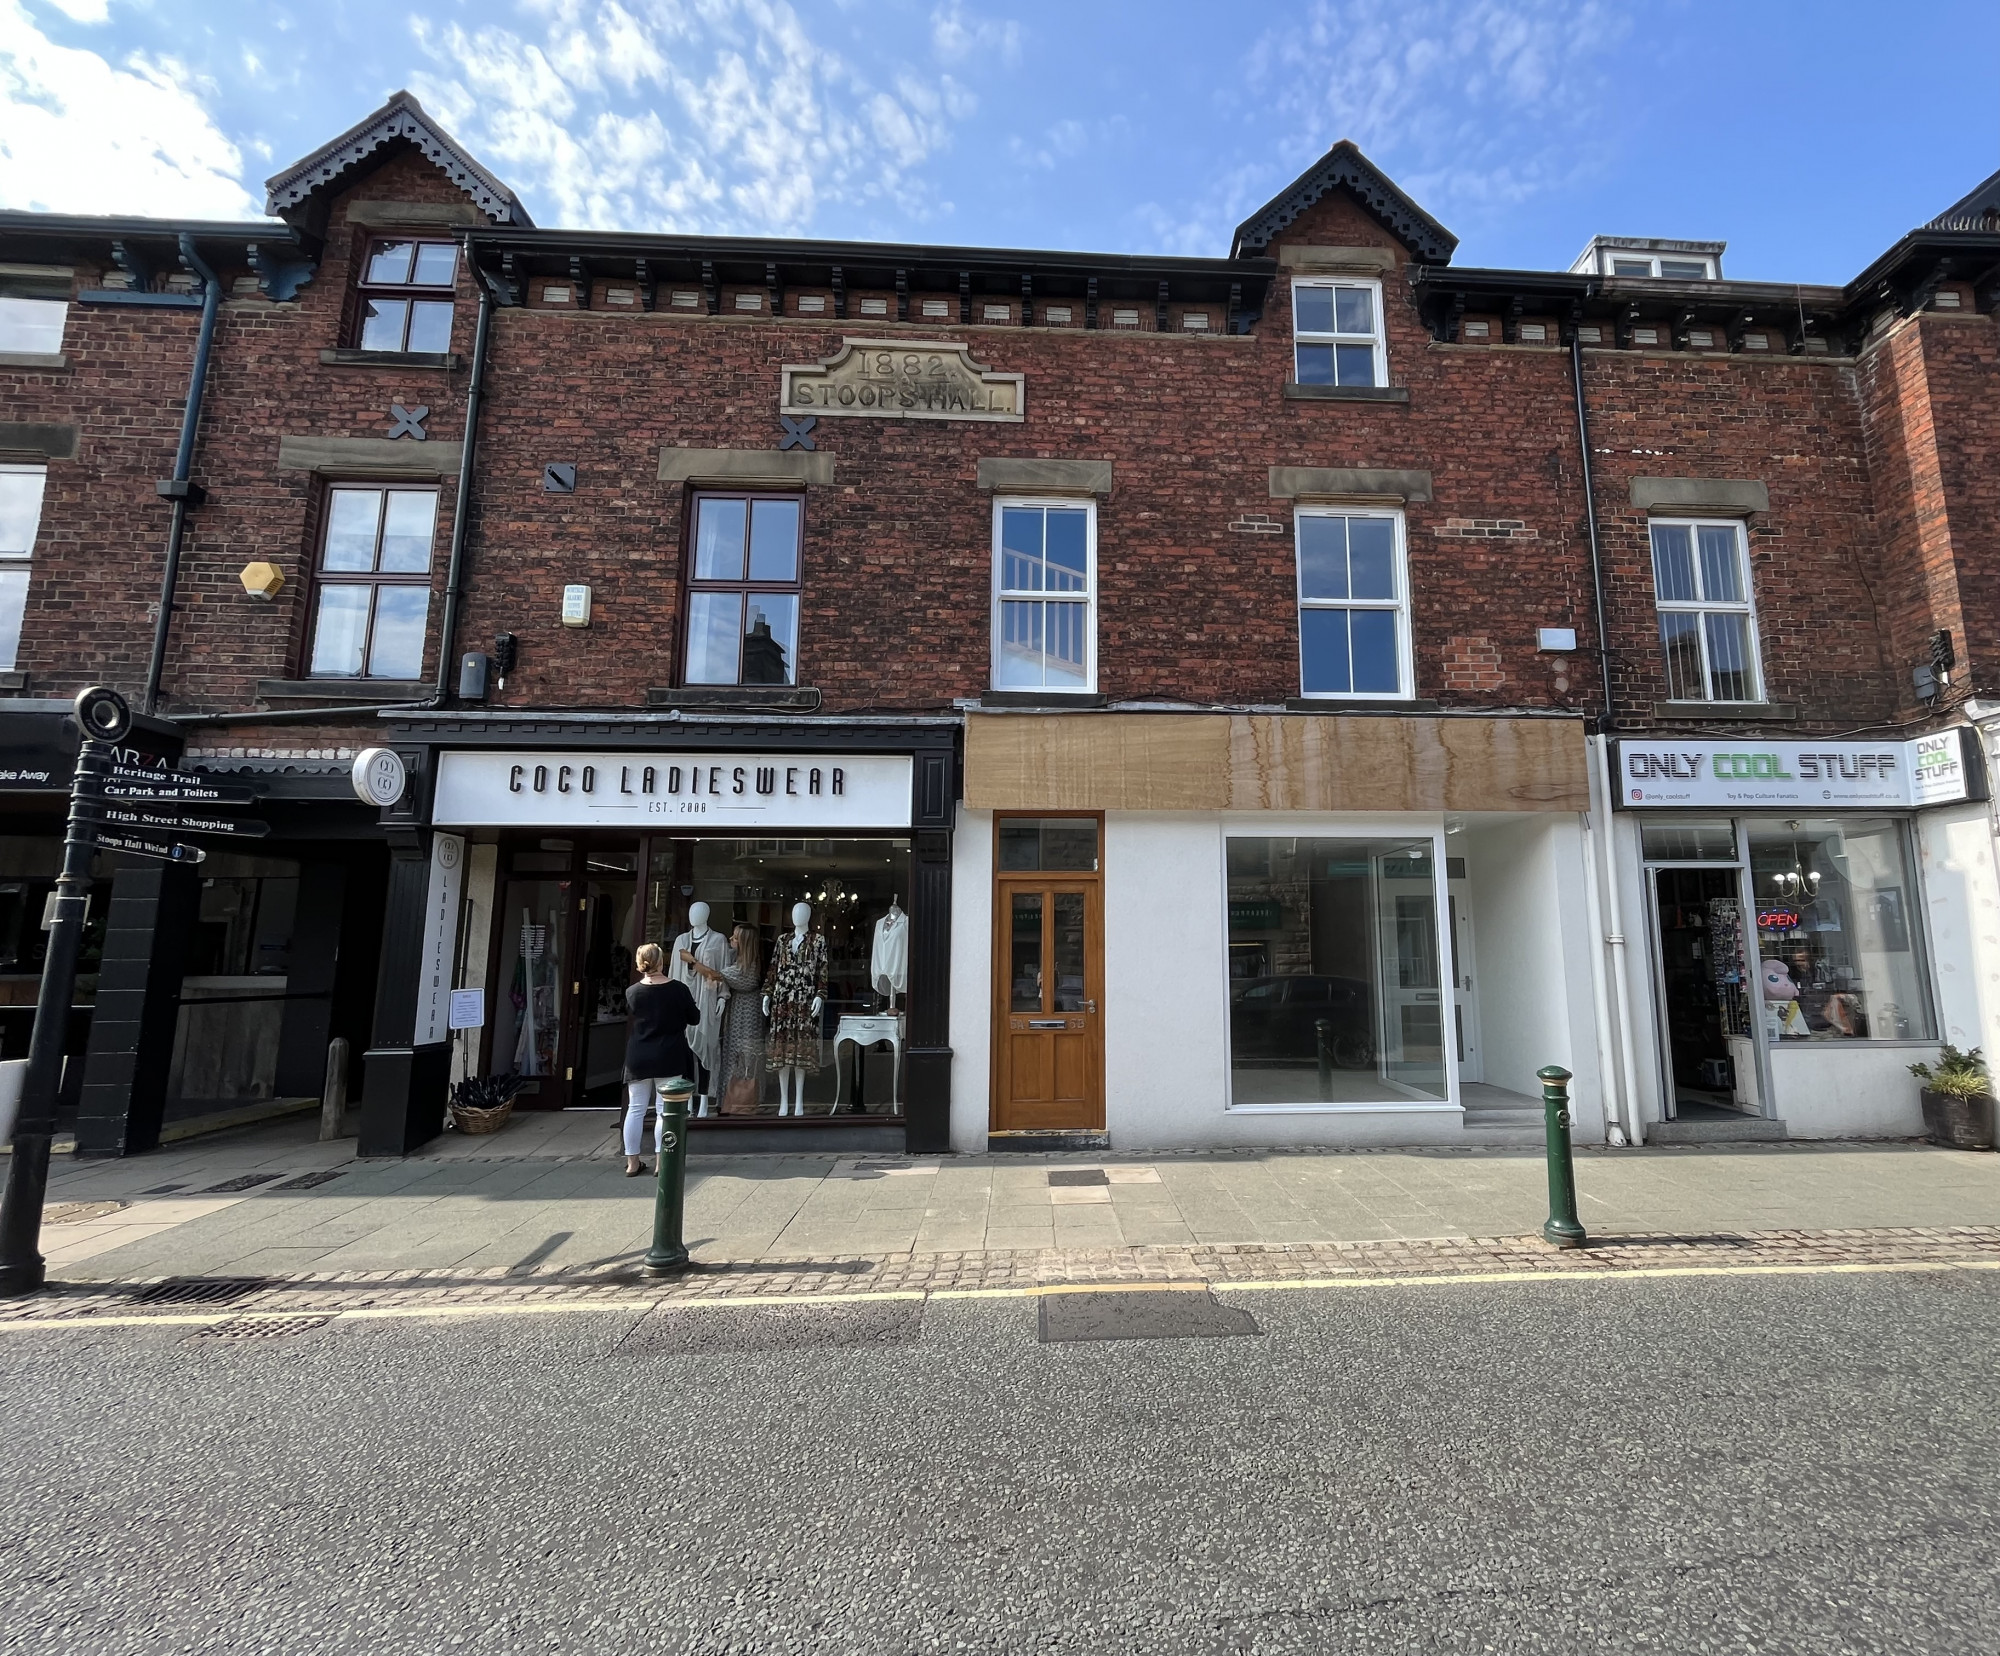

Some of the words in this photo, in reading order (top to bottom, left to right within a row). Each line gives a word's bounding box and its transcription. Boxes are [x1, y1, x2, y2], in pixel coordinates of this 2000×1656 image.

[797, 383, 916, 407] STOOPS
[1916, 736, 1949, 755] ONLY
[1628, 753, 1703, 778] ONLY
[1712, 753, 1793, 779] COOL
[1798, 753, 1896, 779] STUFF
[1917, 750, 1953, 768] COOL
[0, 769, 17, 780] ake
[18, 769, 50, 782] Away
[113, 766, 166, 781] Heritage
[171, 773, 201, 785] Trail
[509, 765, 596, 793] COCO
[620, 766, 845, 795] LADIESWEAR
[1914, 760, 1959, 781] STUFF
[104, 785, 126, 795] Car
[129, 787, 155, 796] Park
[158, 789, 178, 797] and
[182, 788, 219, 798] Toilets
[648, 801, 673, 813] EST.
[680, 802, 707, 813] 2008
[106, 810, 138, 821] High
[142, 813, 178, 825] Street
[181, 817, 234, 831] Shopping
[96, 833, 123, 847] Stoops
[124, 839, 142, 850] Hall
[1757, 913, 1798, 927] OPEN
[429, 875, 448, 1039] LADIESWEAR
